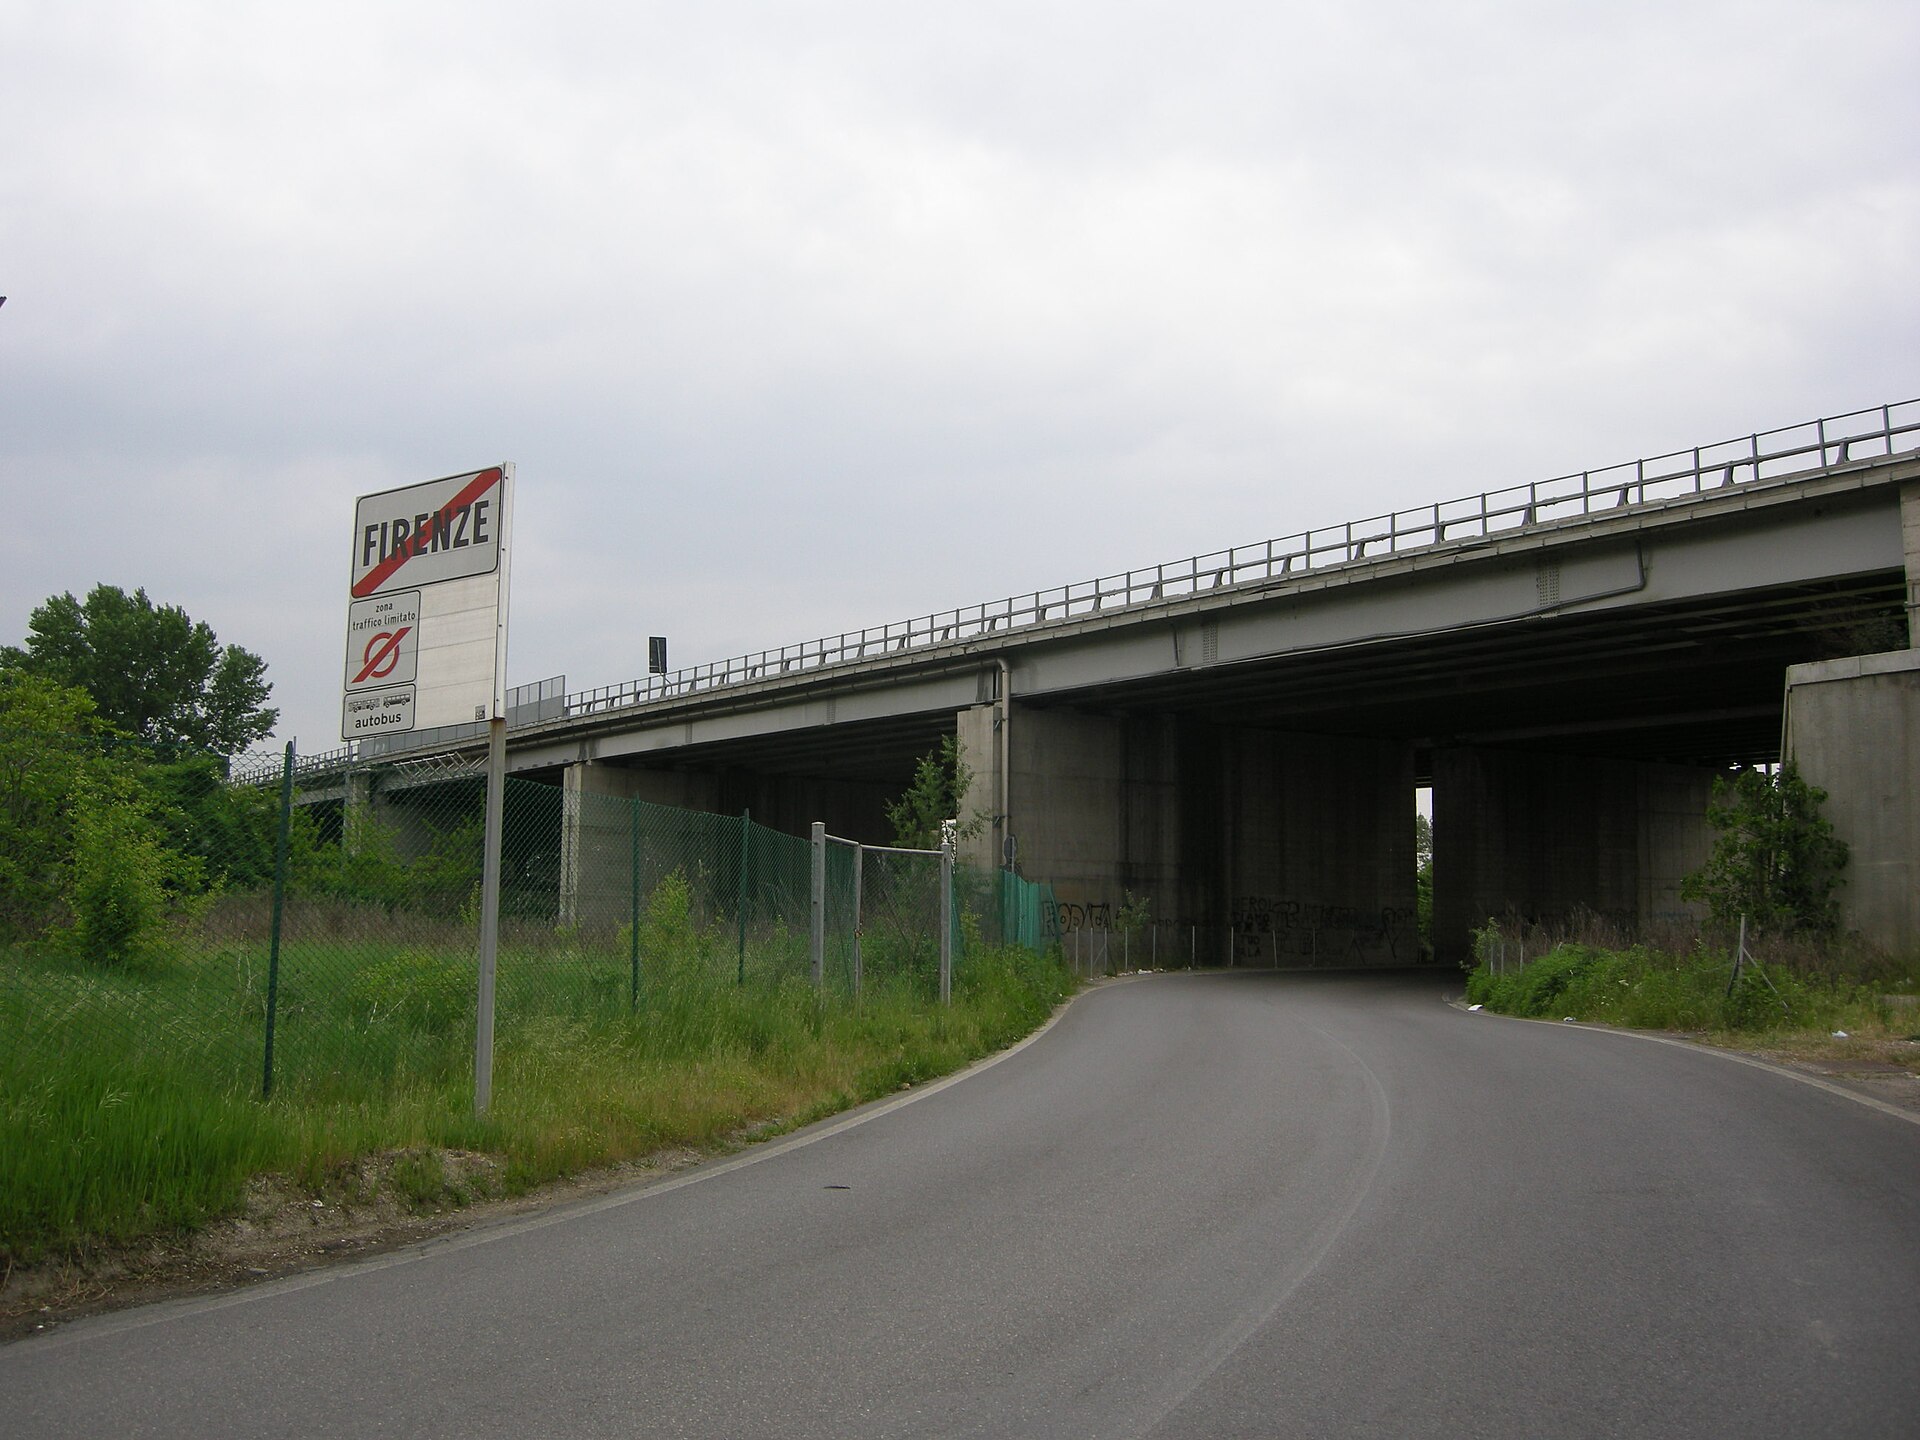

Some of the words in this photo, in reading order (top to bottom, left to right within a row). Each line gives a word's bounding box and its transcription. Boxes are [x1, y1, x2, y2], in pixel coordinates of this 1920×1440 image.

[363, 500, 489, 567] FIRENZE
[376, 602, 393, 613] zona
[352, 617, 382, 631] traffico
[384, 611, 416, 625] limitato
[355, 712, 402, 729] autobus
